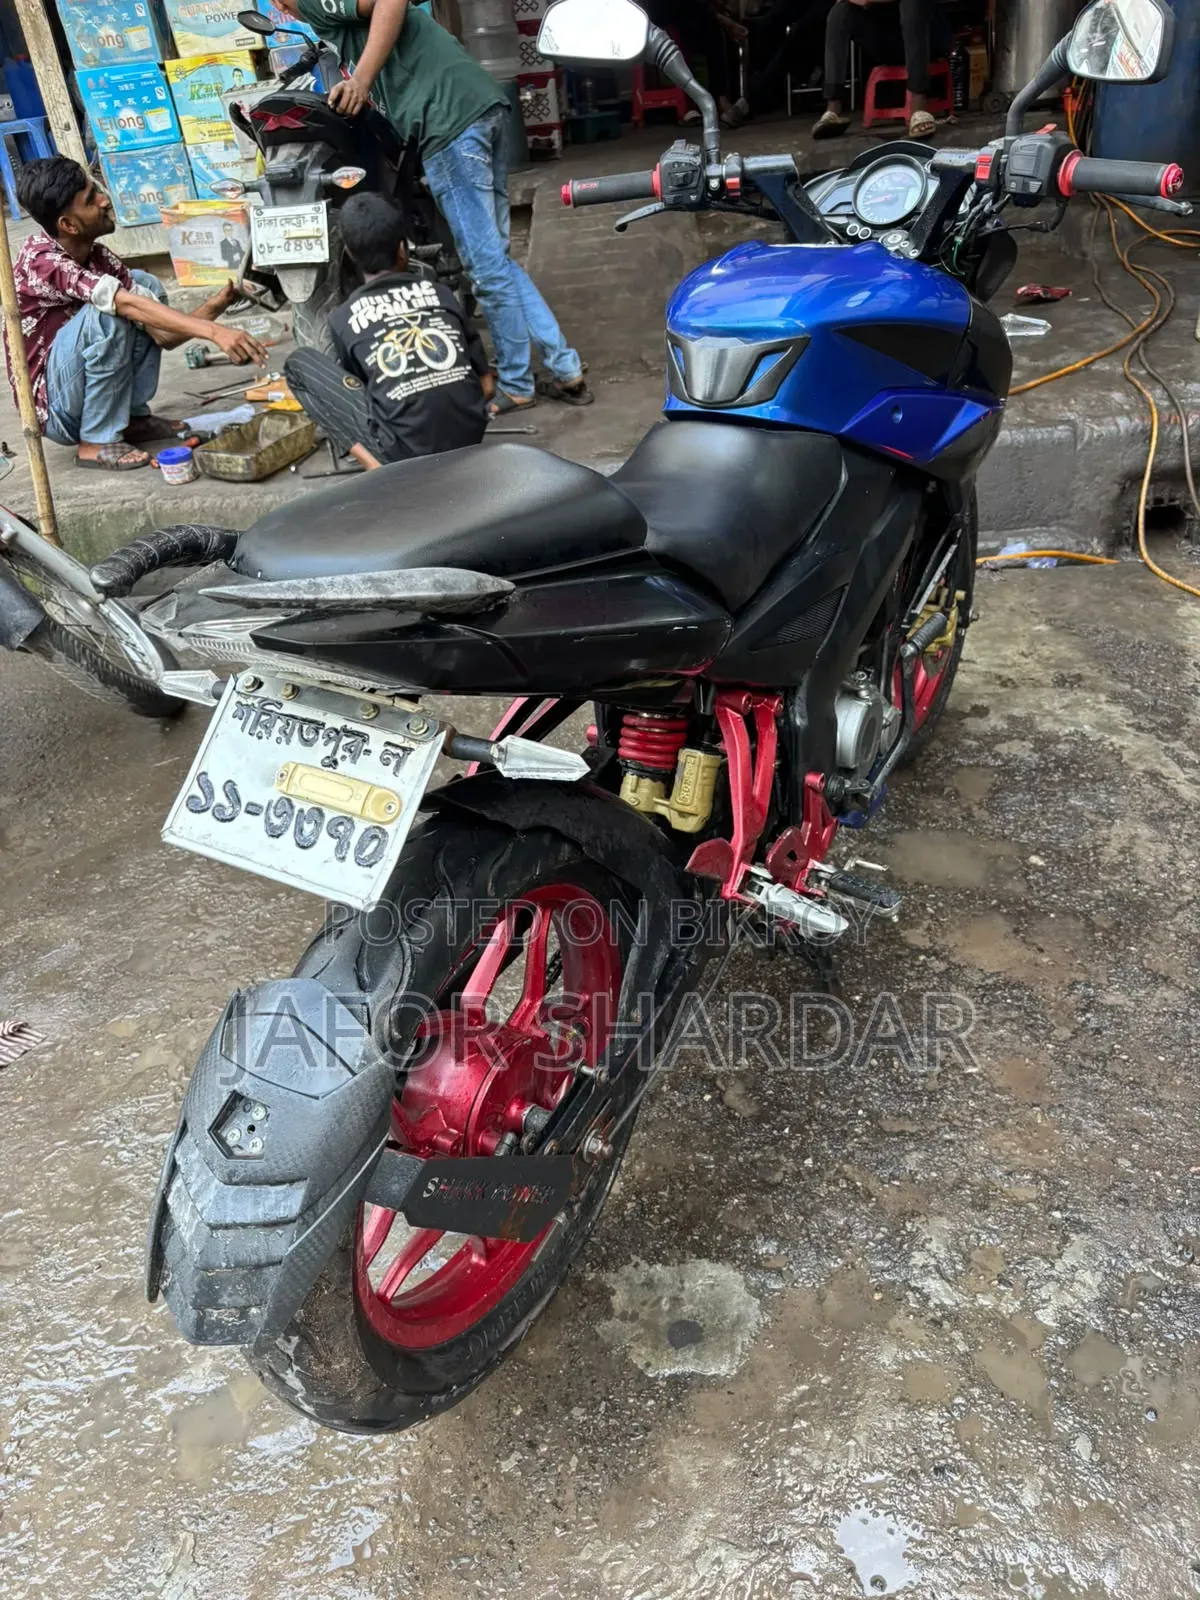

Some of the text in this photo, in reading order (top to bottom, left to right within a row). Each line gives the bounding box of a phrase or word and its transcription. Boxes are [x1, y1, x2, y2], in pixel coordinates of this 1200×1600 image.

[205, 11, 240, 24] POWE
[97, 115, 146, 131] Eilong
[119, 191, 165, 206] Eilong
[388, 280, 437, 301] THE
[185, 771, 390, 868] ১১-৩৩৭০
